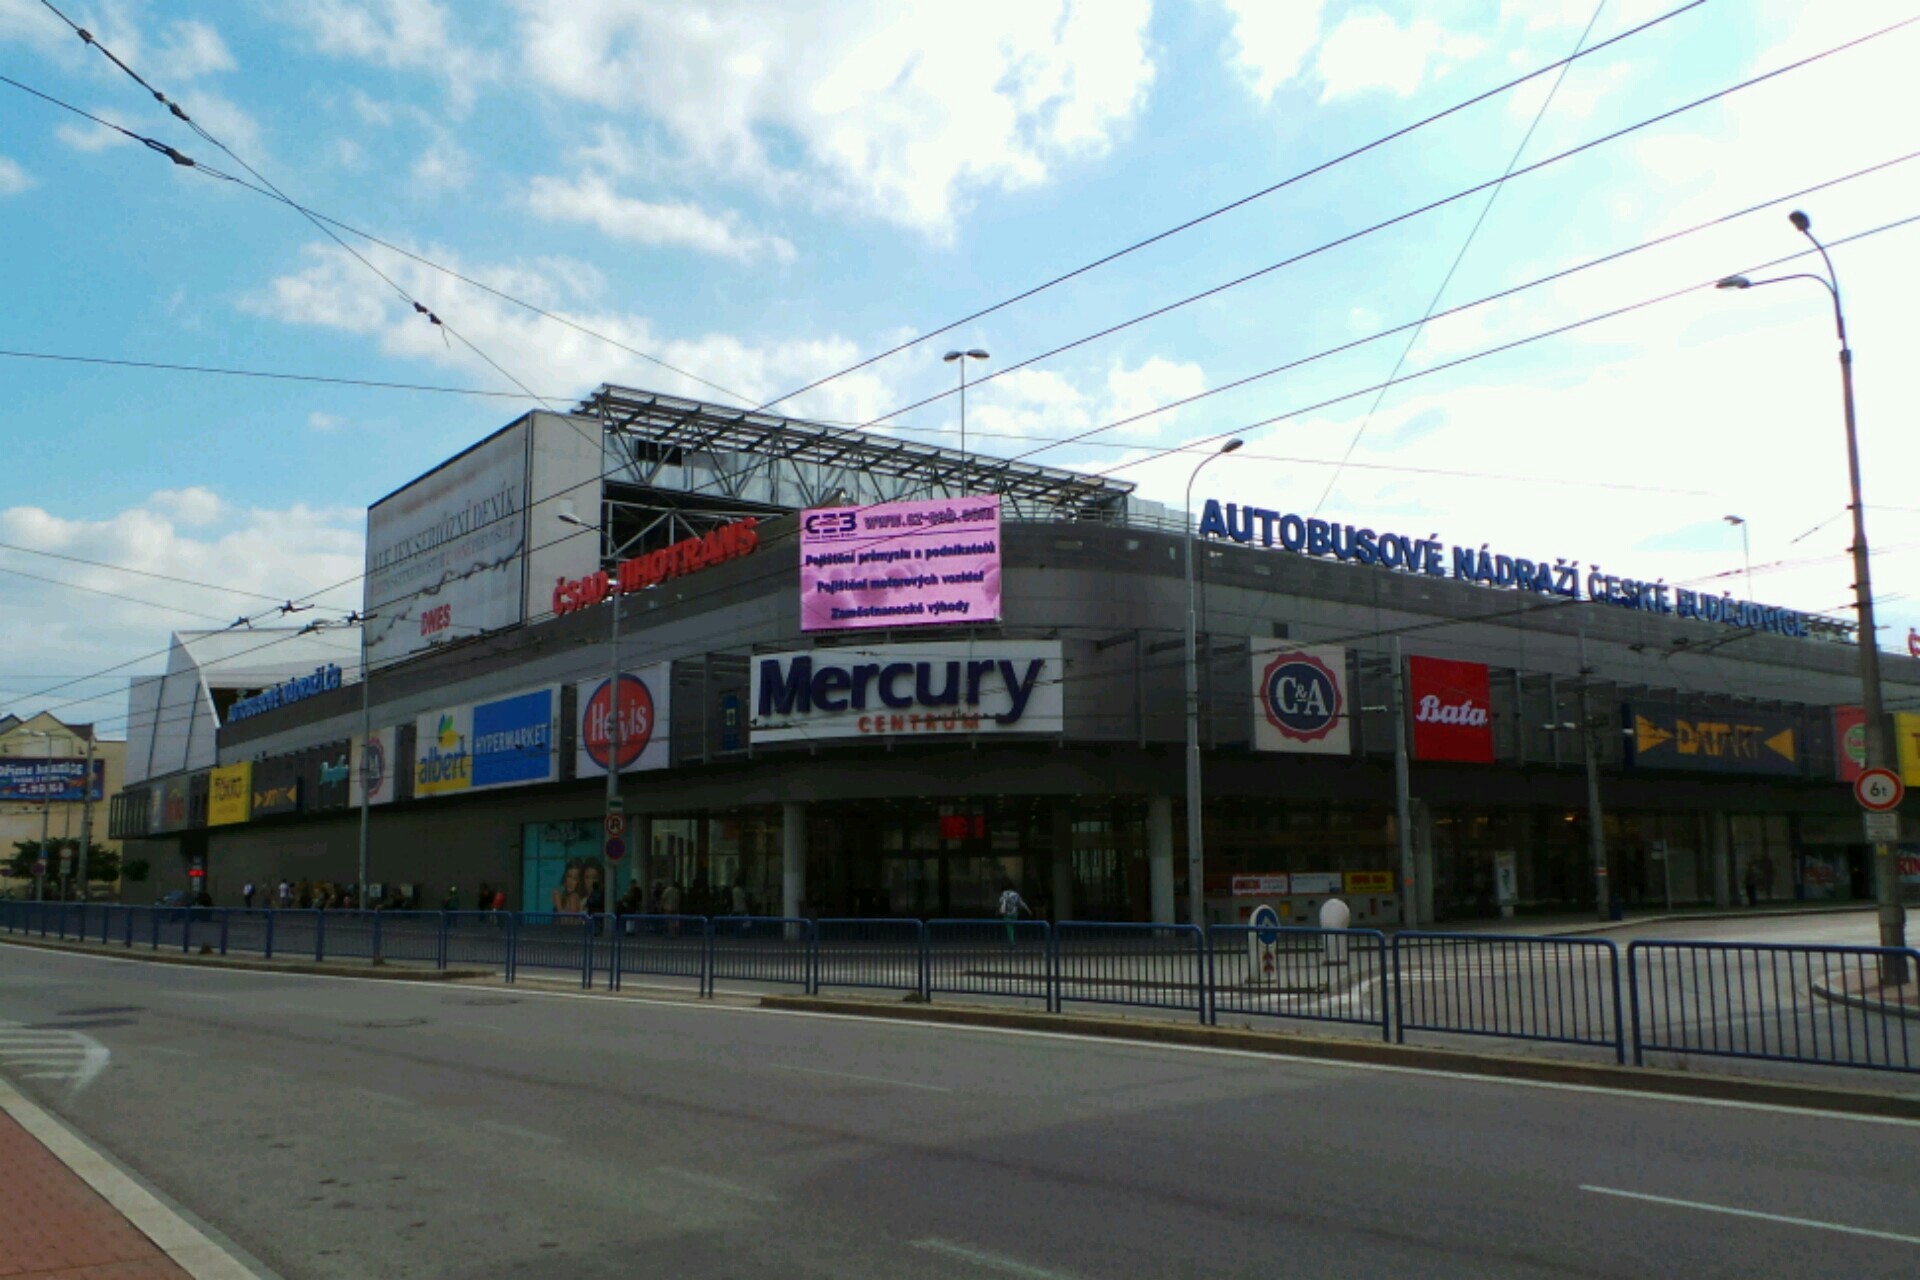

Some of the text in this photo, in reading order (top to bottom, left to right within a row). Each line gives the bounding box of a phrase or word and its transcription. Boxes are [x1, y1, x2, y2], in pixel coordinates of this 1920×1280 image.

[473, 479, 517, 532] DENÍK
[553, 516, 759, 617] ČSAD JIHOTRANS
[914, 550, 923, 559] a
[1200, 498, 1808, 638] AUTOBUSOVÉ NÁDRAŽÍ ČESKÉ BUDĚJOVICE
[942, 570, 985, 584] vozidel
[927, 599, 970, 615] výhody
[758, 656, 1046, 725] Mercury
[1276, 676, 1329, 716] C&A
[475, 723, 548, 756] HYPERMARKET
[857, 713, 981, 734] CENTRUM
[417, 737, 469, 784] albert
